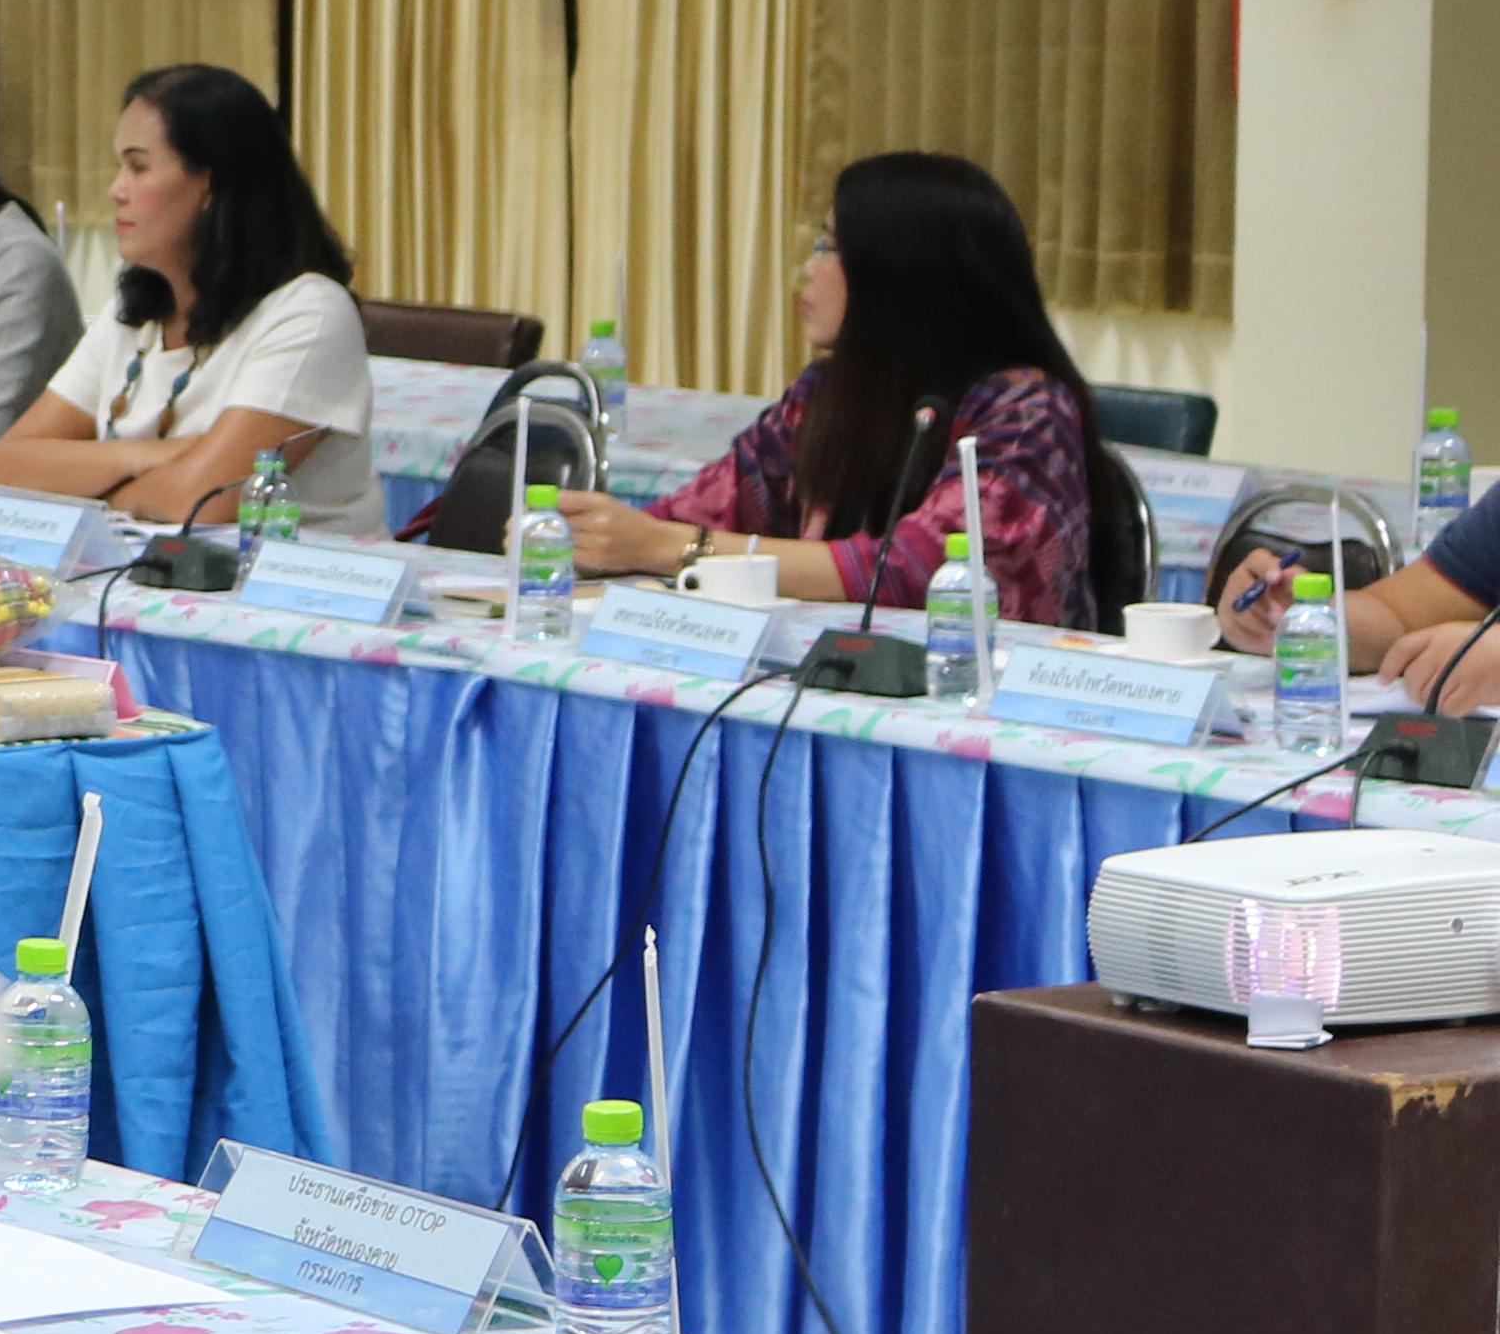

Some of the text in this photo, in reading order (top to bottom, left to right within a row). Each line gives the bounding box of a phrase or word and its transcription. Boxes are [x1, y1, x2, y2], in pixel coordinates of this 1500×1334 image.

[288, 1172, 447, 1234] ประธานเครือข่าย OTOP
[293, 1218, 401, 1271] จังหวัดหนองคาย
[296, 1259, 364, 1295] กรรมการ
